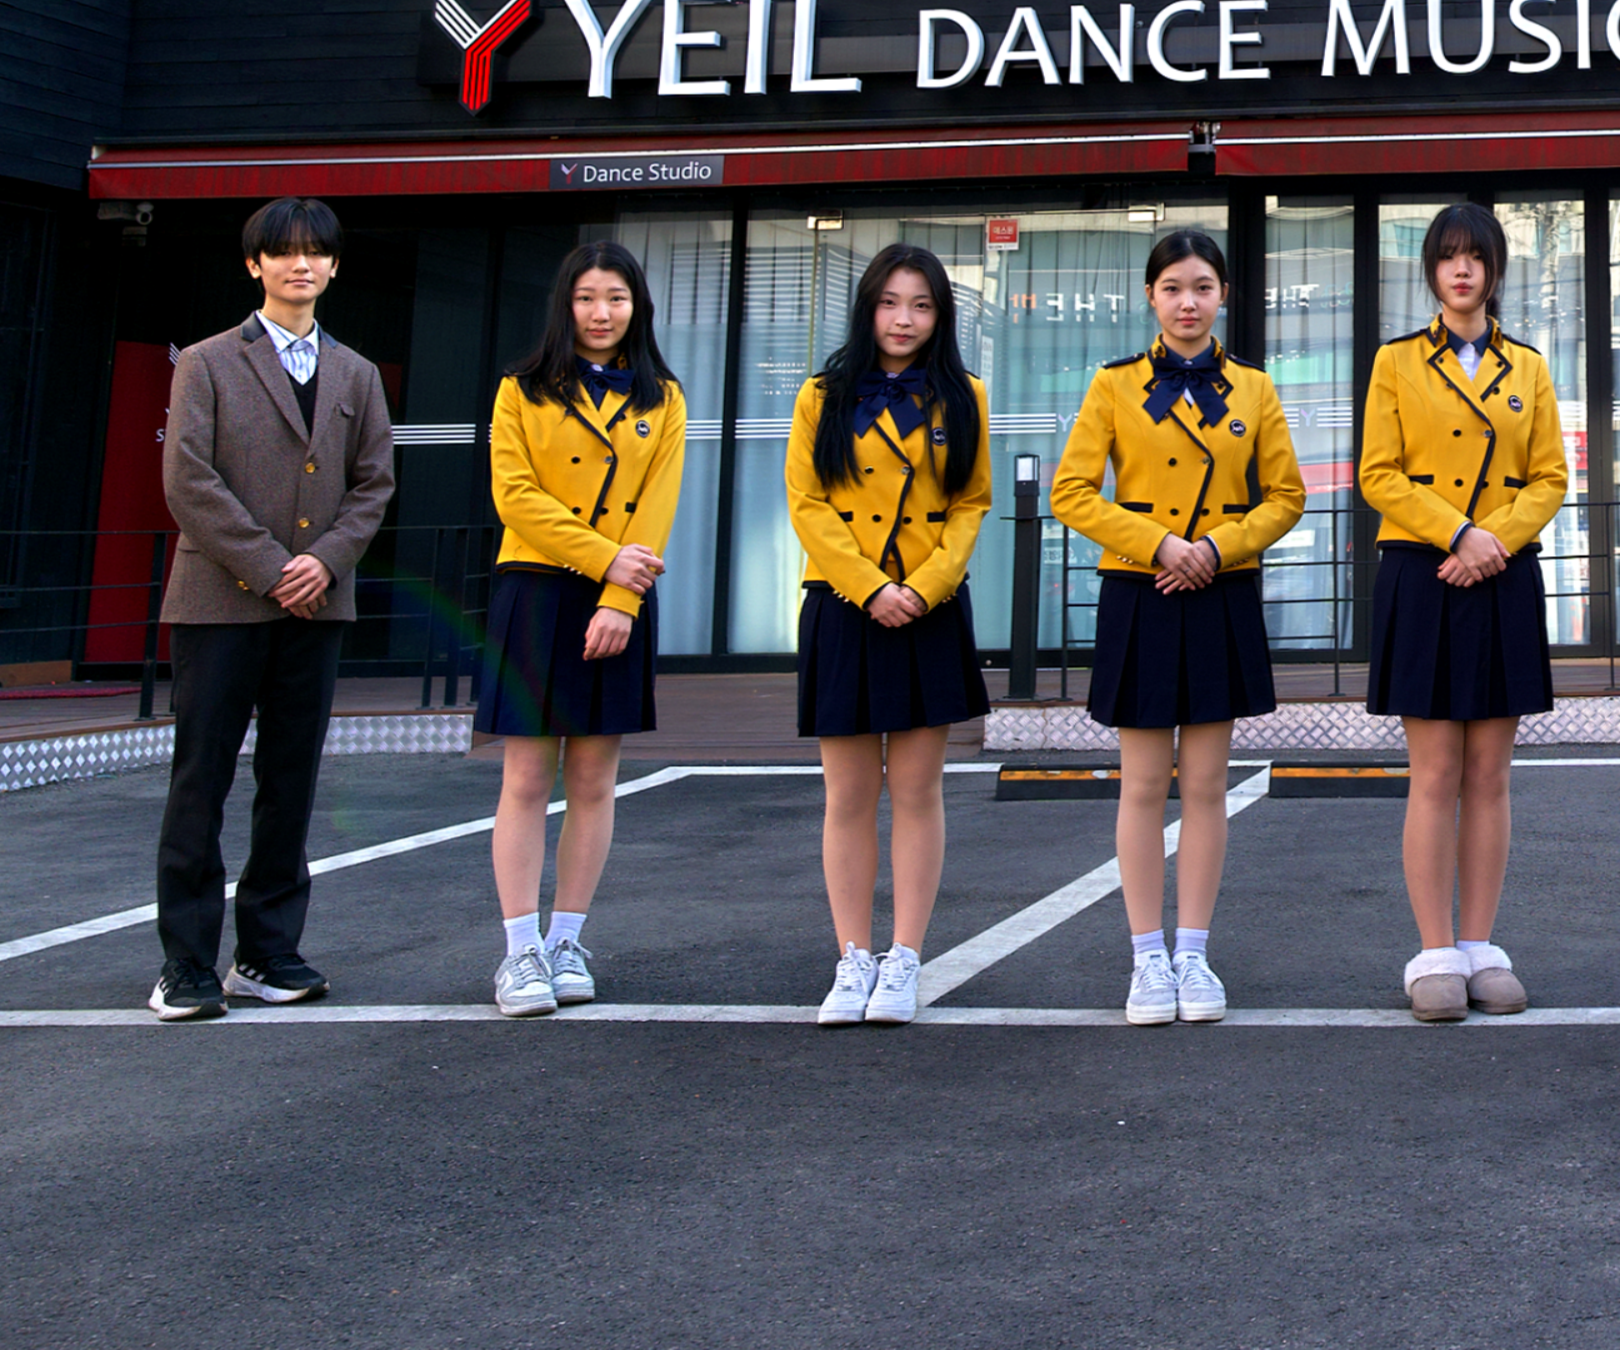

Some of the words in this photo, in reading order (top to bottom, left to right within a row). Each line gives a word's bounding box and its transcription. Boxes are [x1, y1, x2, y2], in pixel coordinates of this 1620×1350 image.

[564, 0, 862, 98] YEIL
[915, 0, 1270, 88] DANCE
[583, 165, 643, 183] Dance
[648, 161, 712, 181] Studio
